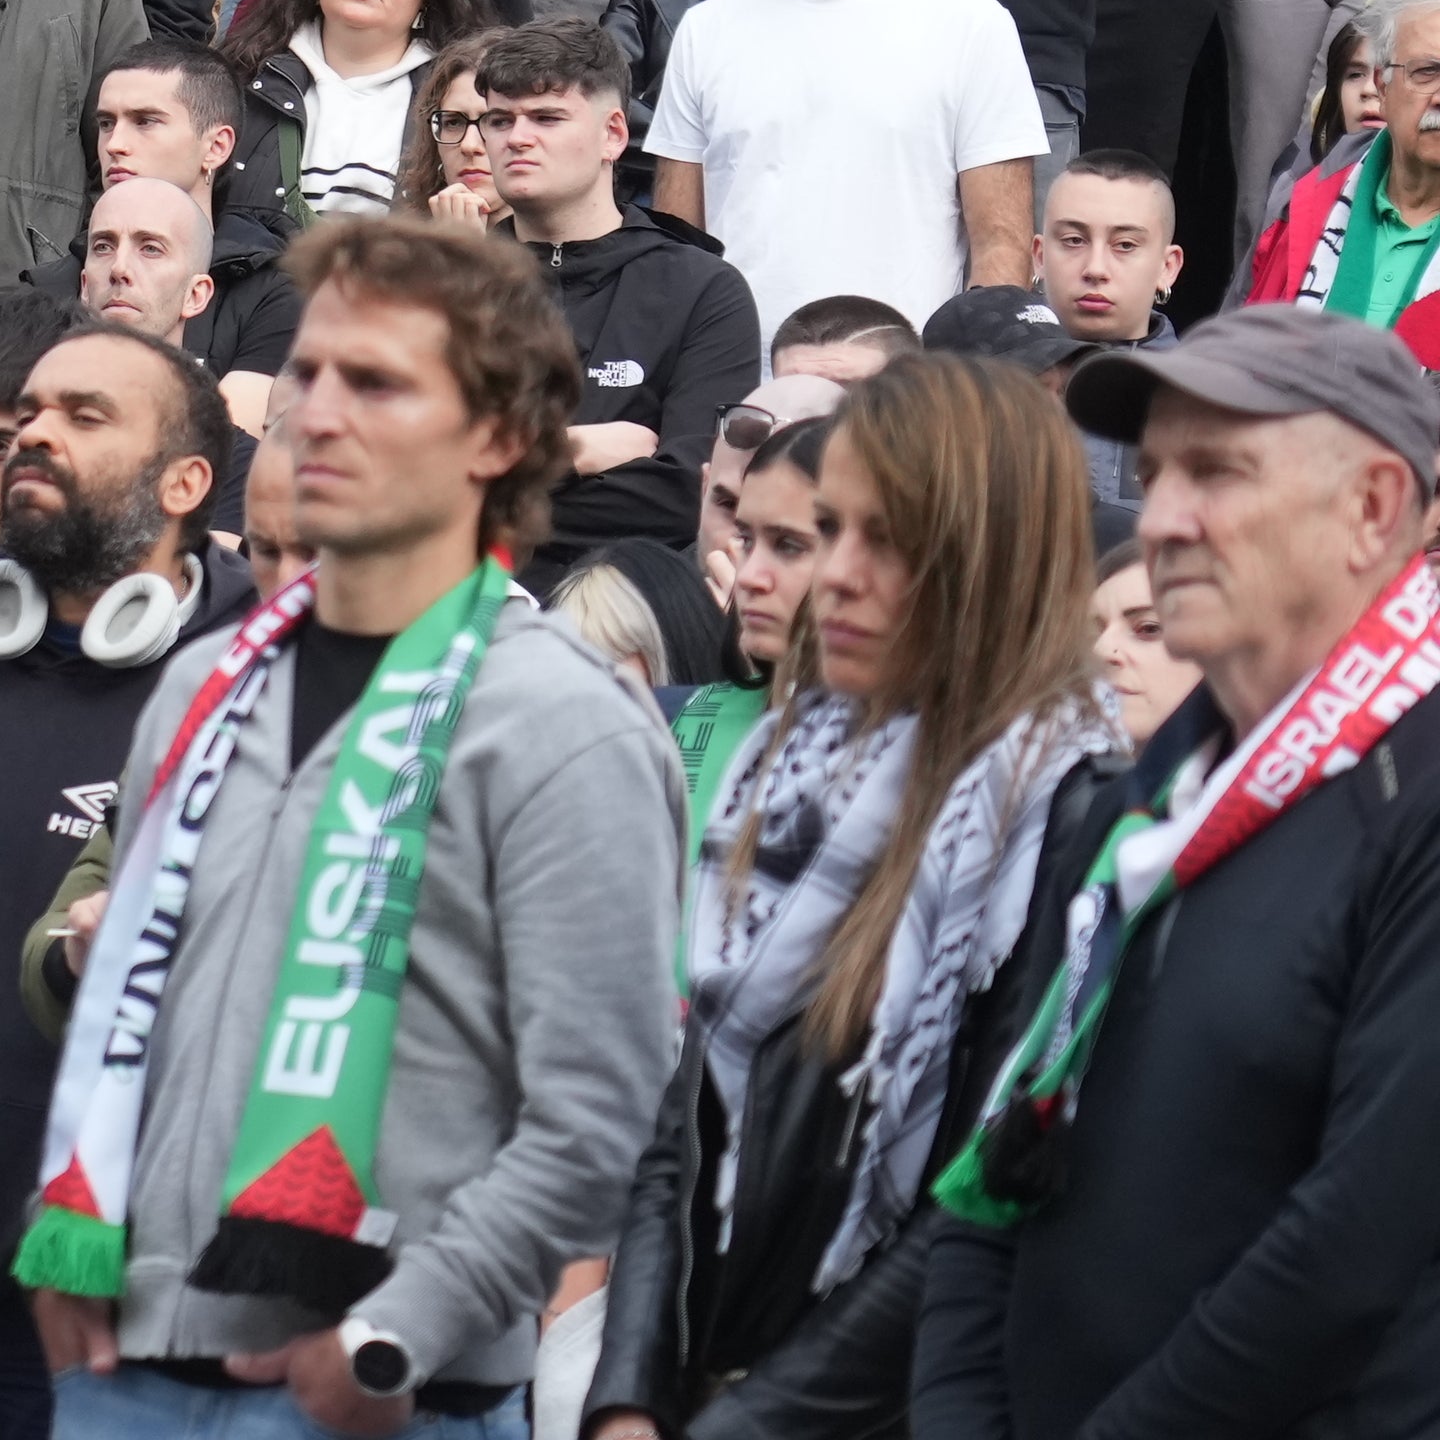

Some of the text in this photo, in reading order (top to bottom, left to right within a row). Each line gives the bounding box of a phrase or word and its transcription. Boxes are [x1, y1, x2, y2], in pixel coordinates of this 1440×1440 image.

[604, 361, 627, 371] THE
[588, 368, 627, 379] NORTH
[599, 378, 627, 387] FACE
[1244, 644, 1405, 810] ISRAEL
